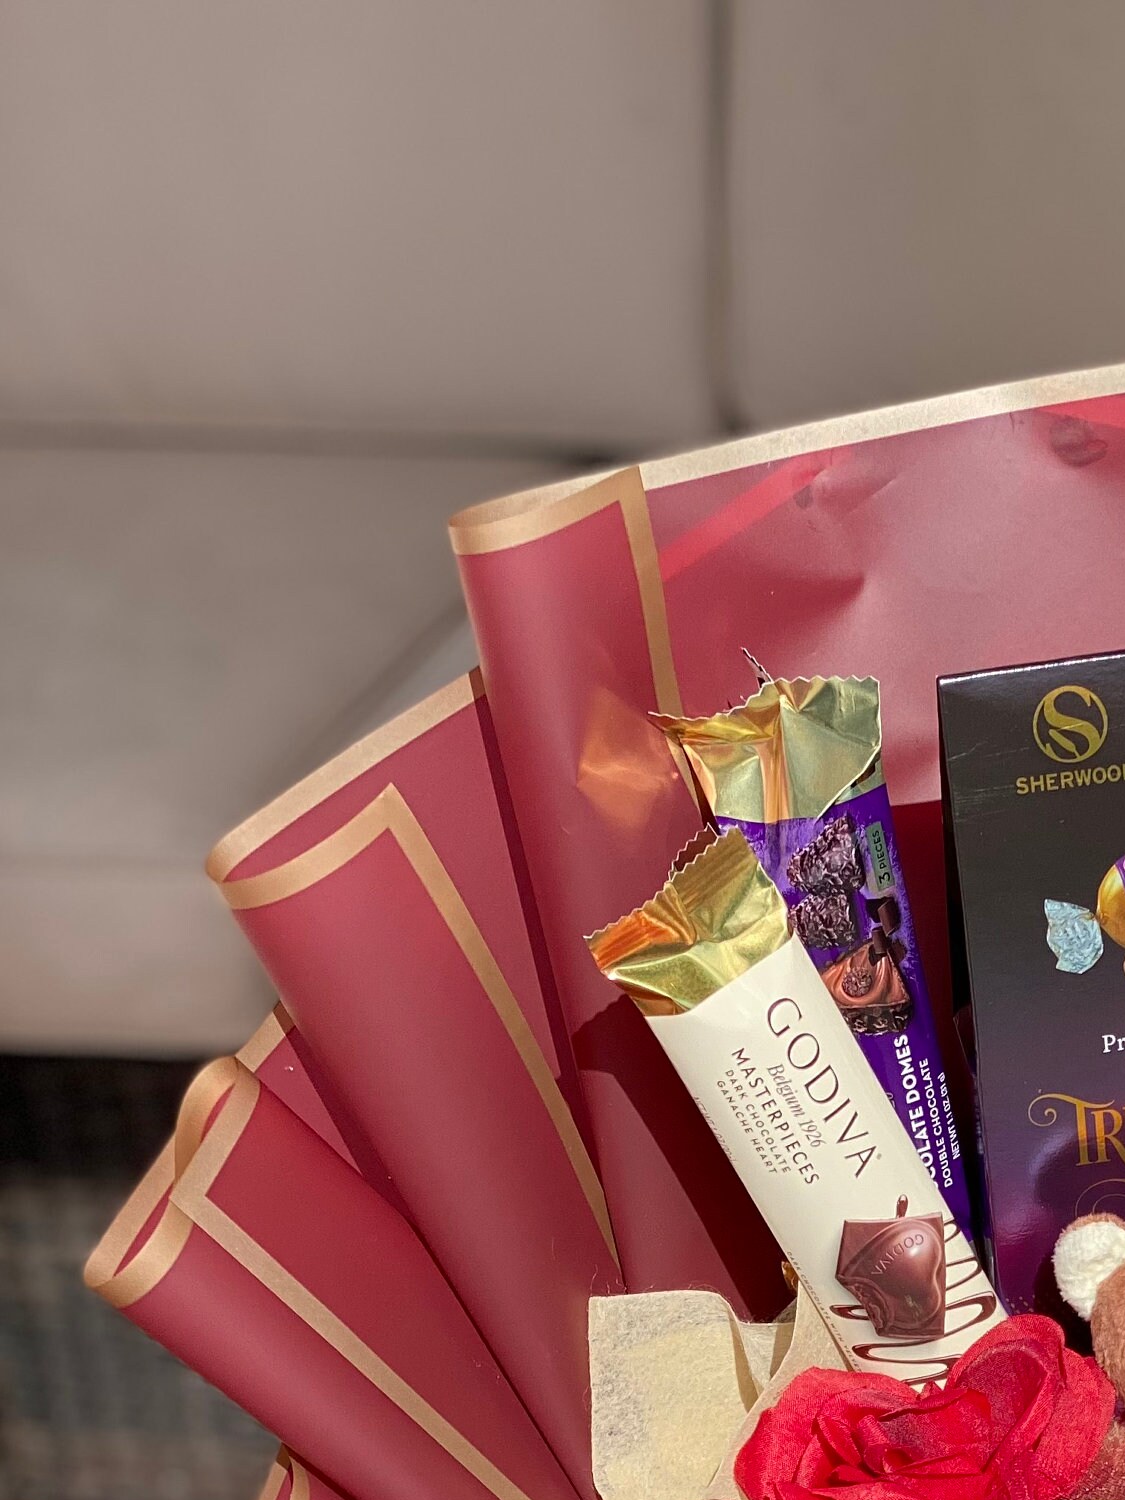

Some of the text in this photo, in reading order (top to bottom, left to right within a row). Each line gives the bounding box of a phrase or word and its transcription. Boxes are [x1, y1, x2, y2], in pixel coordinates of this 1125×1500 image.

[872, 830, 891, 884] 3 PIECES
[767, 997, 877, 1179] GODIVA
[767, 1063, 828, 1148] Belgium 1926
[893, 1034, 921, 1104] DOMES
[716, 1080, 778, 1174] GANACHE HEART
[725, 1069, 791, 1173] DARK CHOCOLATE
[731, 1047, 820, 1185] MASTERPIECES
[919, 1058, 953, 1188] DOUBLE CHOCOLATE
[948, 1126, 958, 1143] WT
[950, 1142, 961, 1160] NET
[870, 1233, 924, 1275] GODIVA
